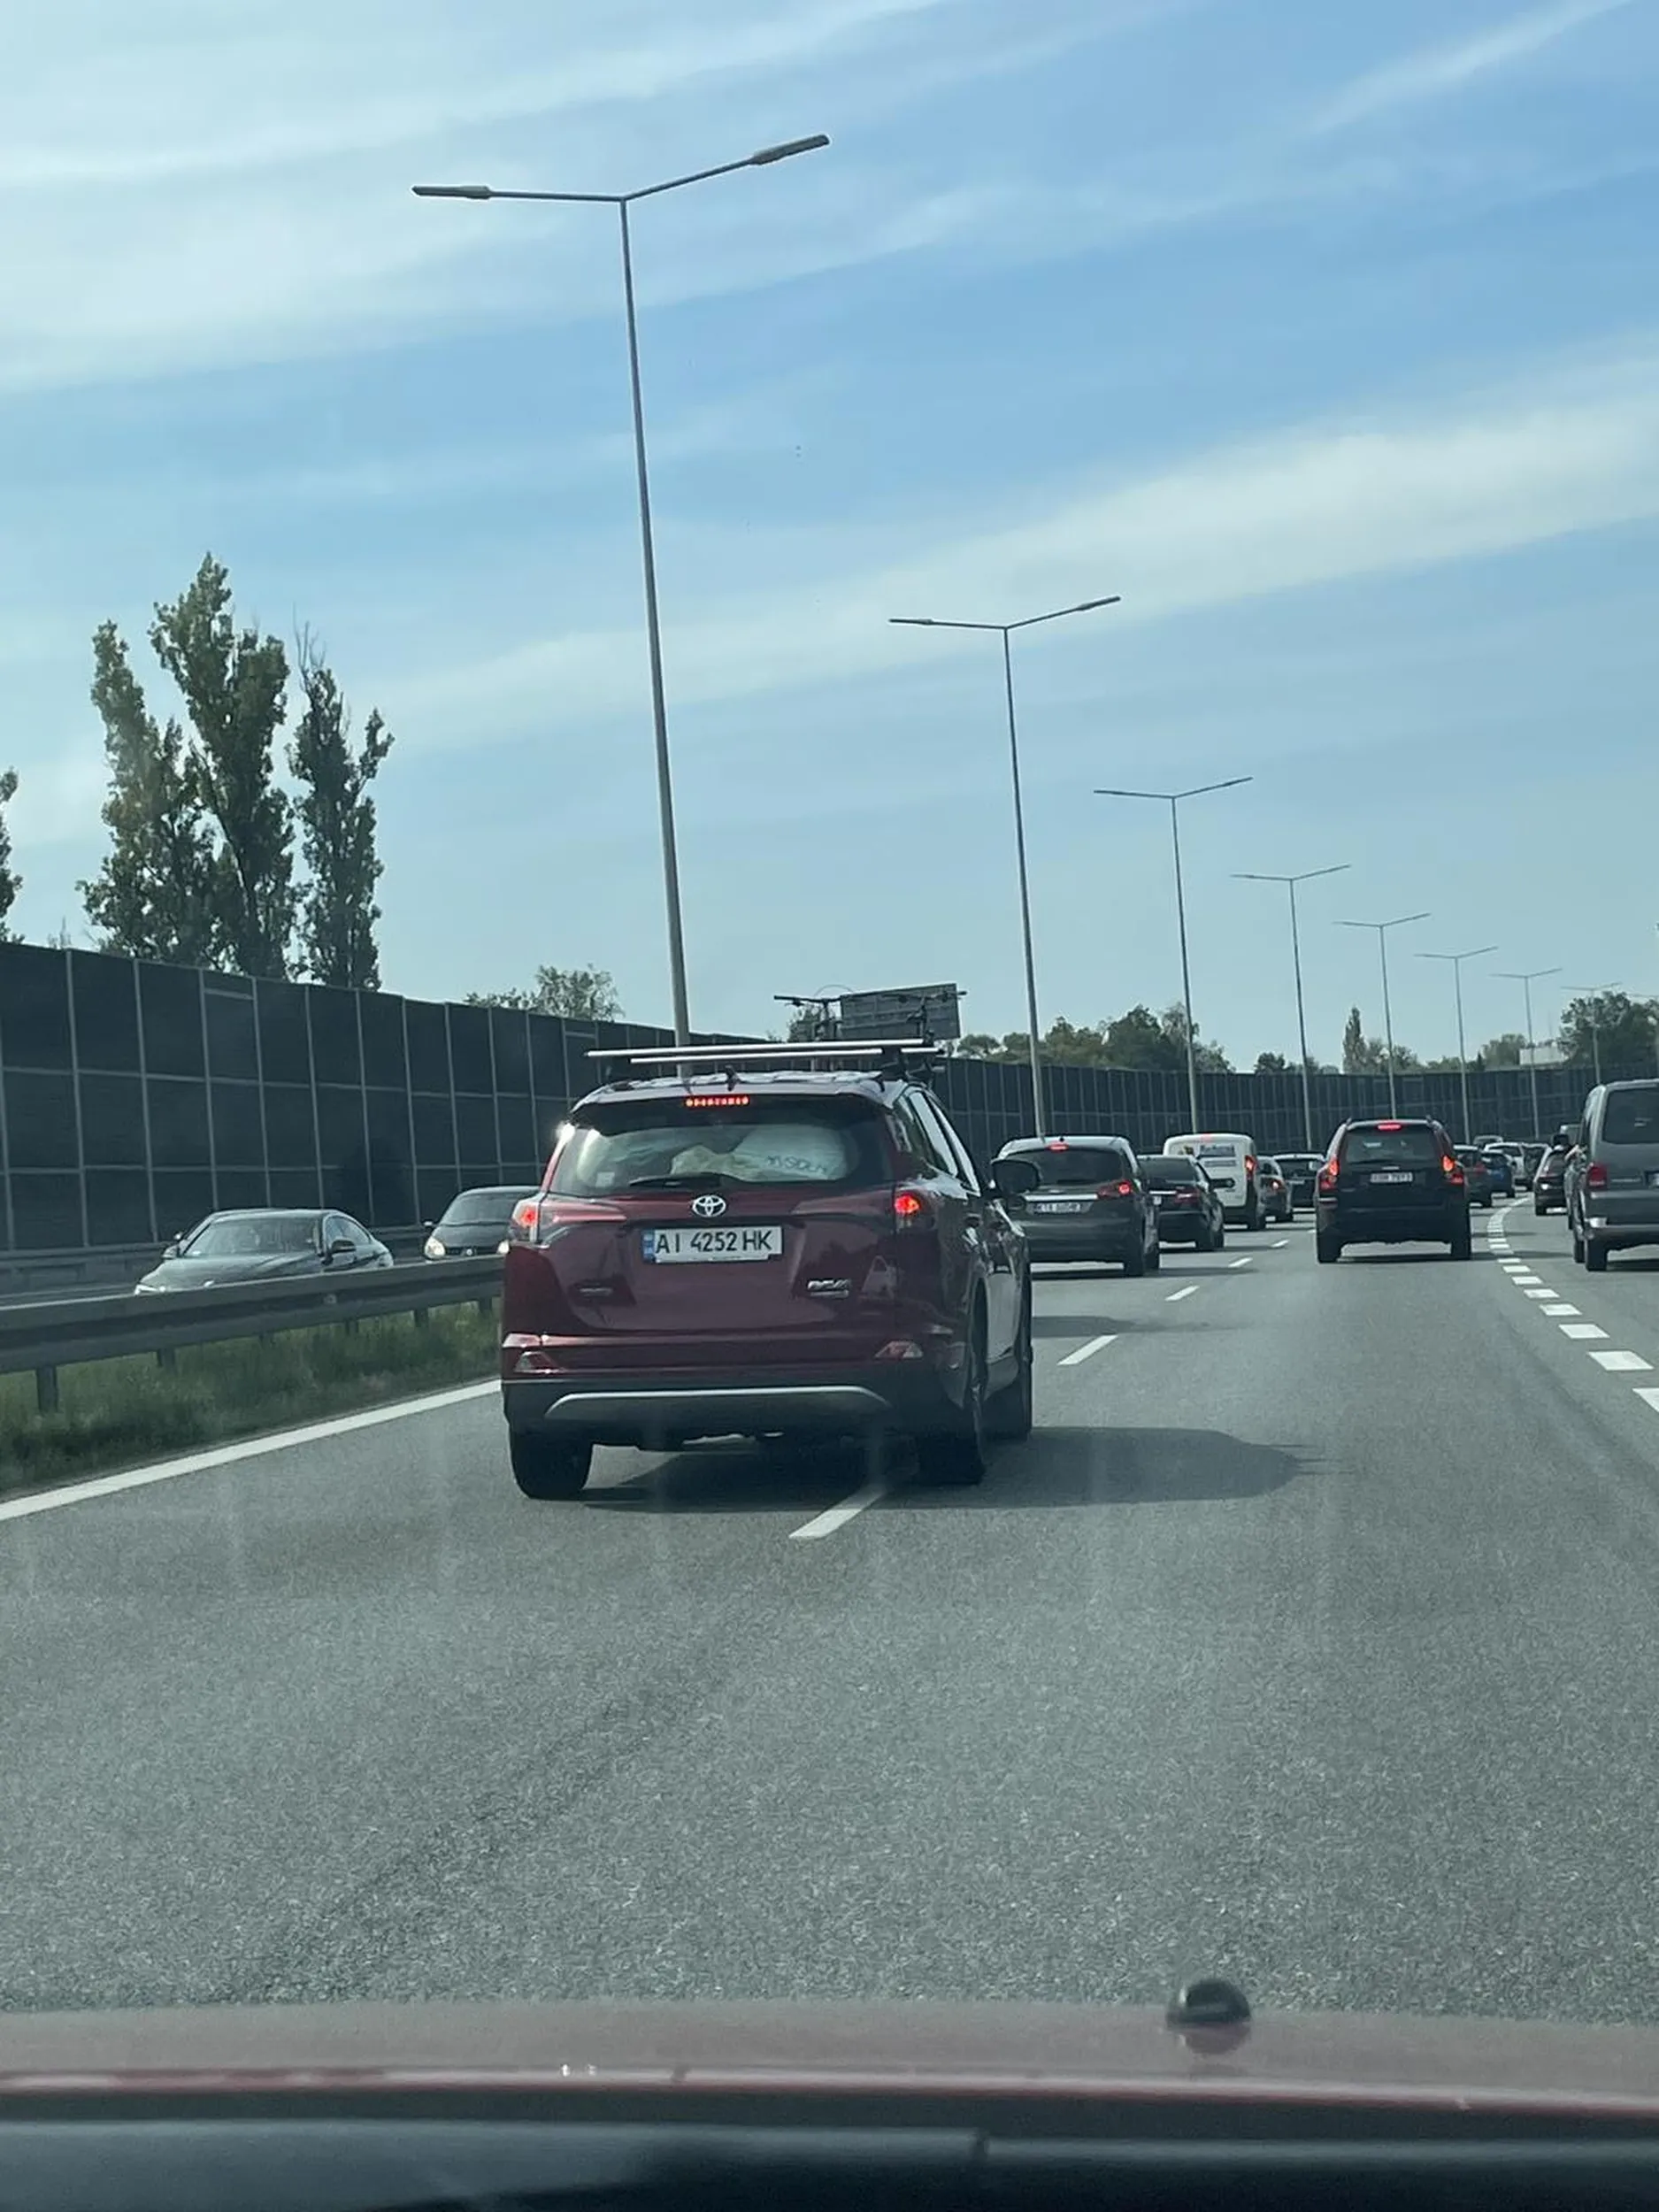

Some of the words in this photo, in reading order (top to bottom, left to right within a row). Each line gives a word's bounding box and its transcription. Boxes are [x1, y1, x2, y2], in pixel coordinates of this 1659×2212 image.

[656, 1233, 680, 1254] AI
[690, 1231, 738, 1253] 4252
[742, 1230, 772, 1251] HK
